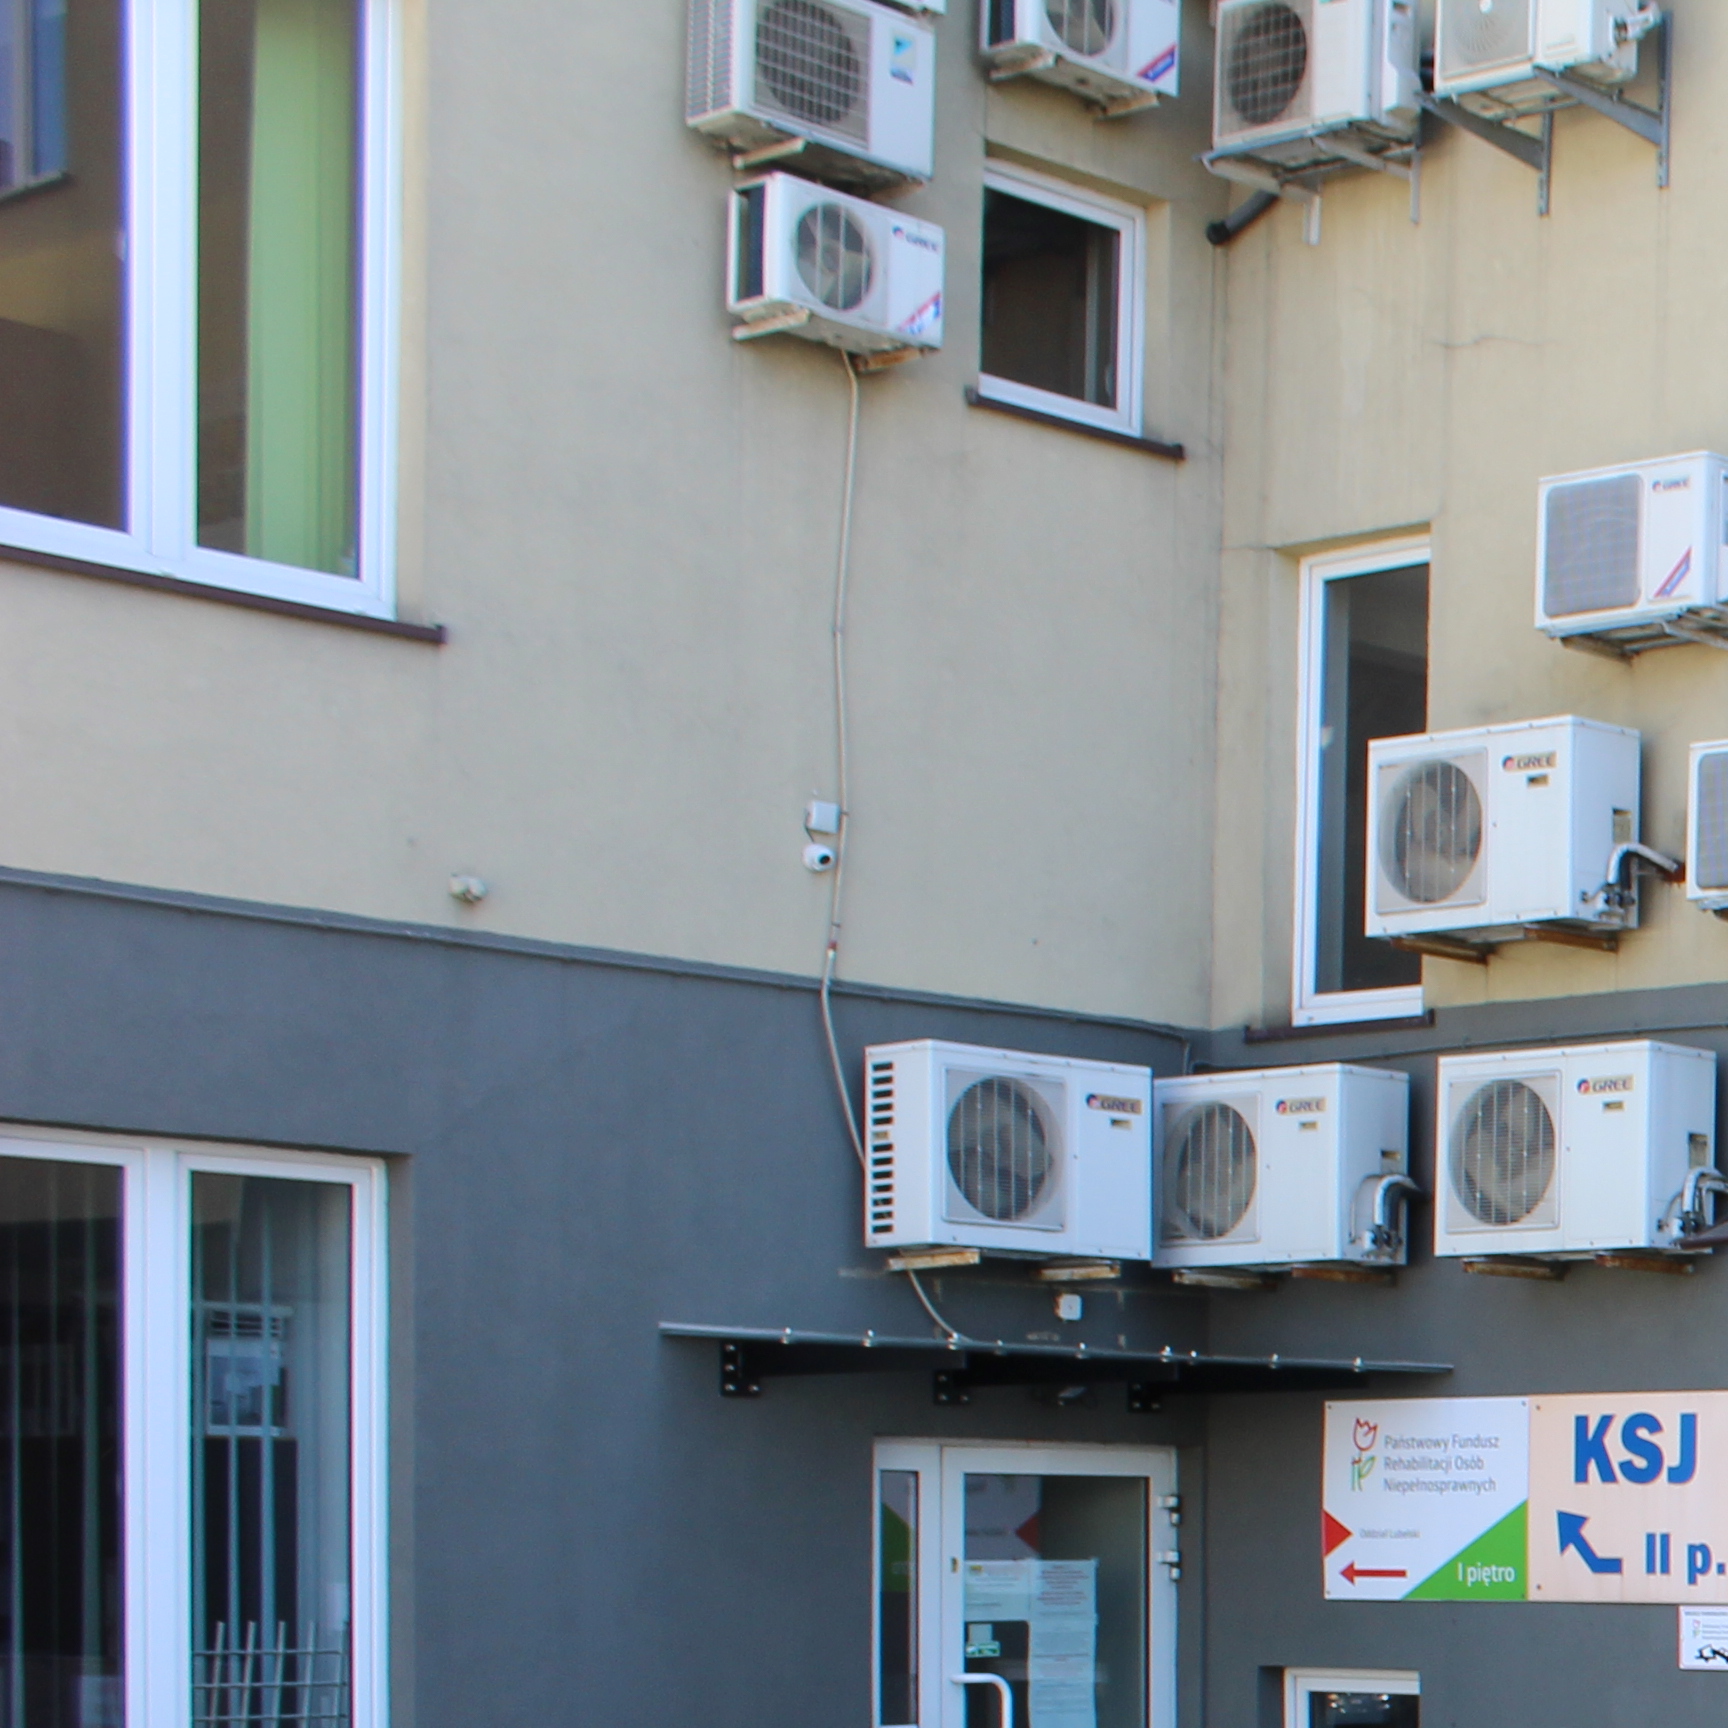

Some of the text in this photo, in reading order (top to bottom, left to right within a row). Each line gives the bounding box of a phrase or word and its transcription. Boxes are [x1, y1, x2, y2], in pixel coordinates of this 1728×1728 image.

[1384, 1433, 1500, 1451] Państwowy Fundusz
[1574, 1411, 1698, 1485] KSJ
[1384, 1455, 1485, 1473] Rehabilitacji Osób
[1384, 1476, 1497, 1496] Niepełnosprawnych
[1457, 1562, 1516, 1587] I piętro
[1686, 1542, 1727, 1586] p.
